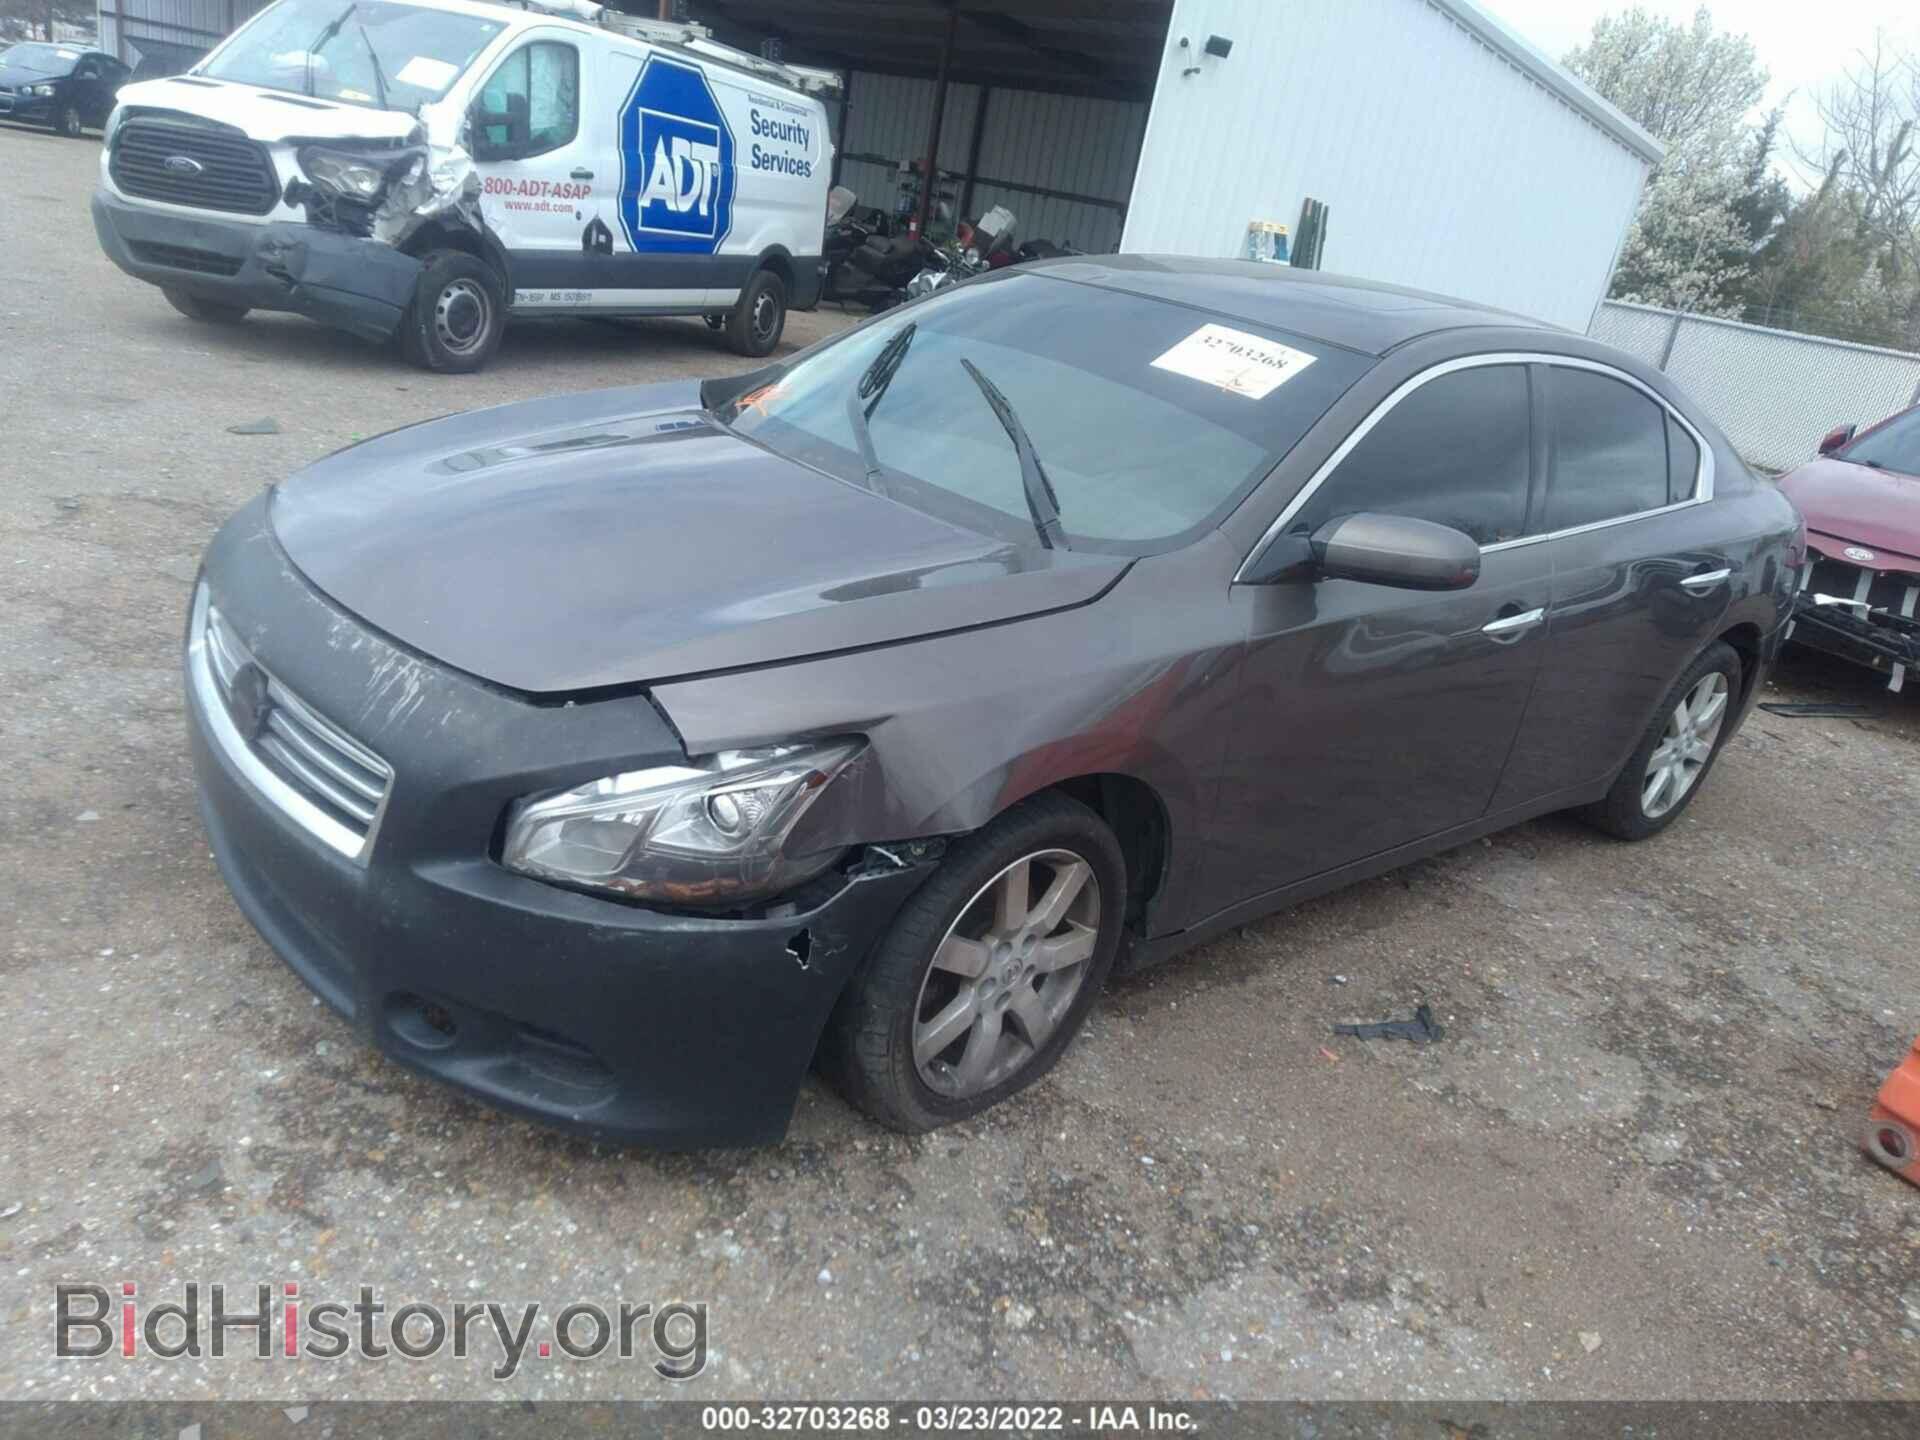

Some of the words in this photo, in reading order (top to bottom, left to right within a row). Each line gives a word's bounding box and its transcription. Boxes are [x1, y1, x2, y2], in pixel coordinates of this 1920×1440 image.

[750, 108, 809, 151] Security
[638, 135, 719, 216] ADT
[752, 143, 811, 178] Services
[504, 200, 574, 213] www.adt.com
